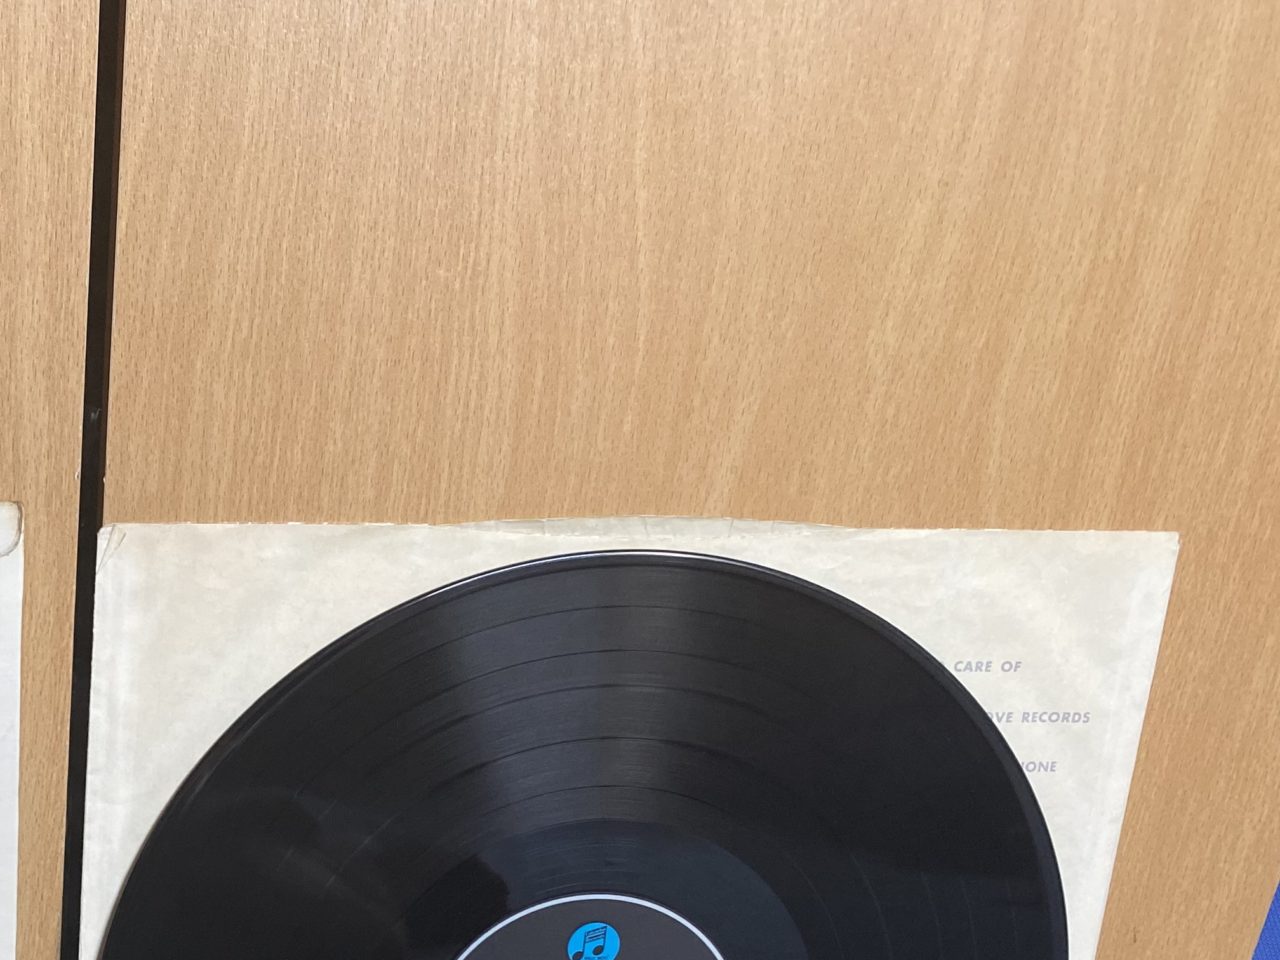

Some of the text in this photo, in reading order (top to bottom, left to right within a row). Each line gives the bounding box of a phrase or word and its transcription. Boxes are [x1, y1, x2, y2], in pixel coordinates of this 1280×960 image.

[953, 660, 1022, 673] CARE OF
[1021, 711, 1091, 724] RECORDS
